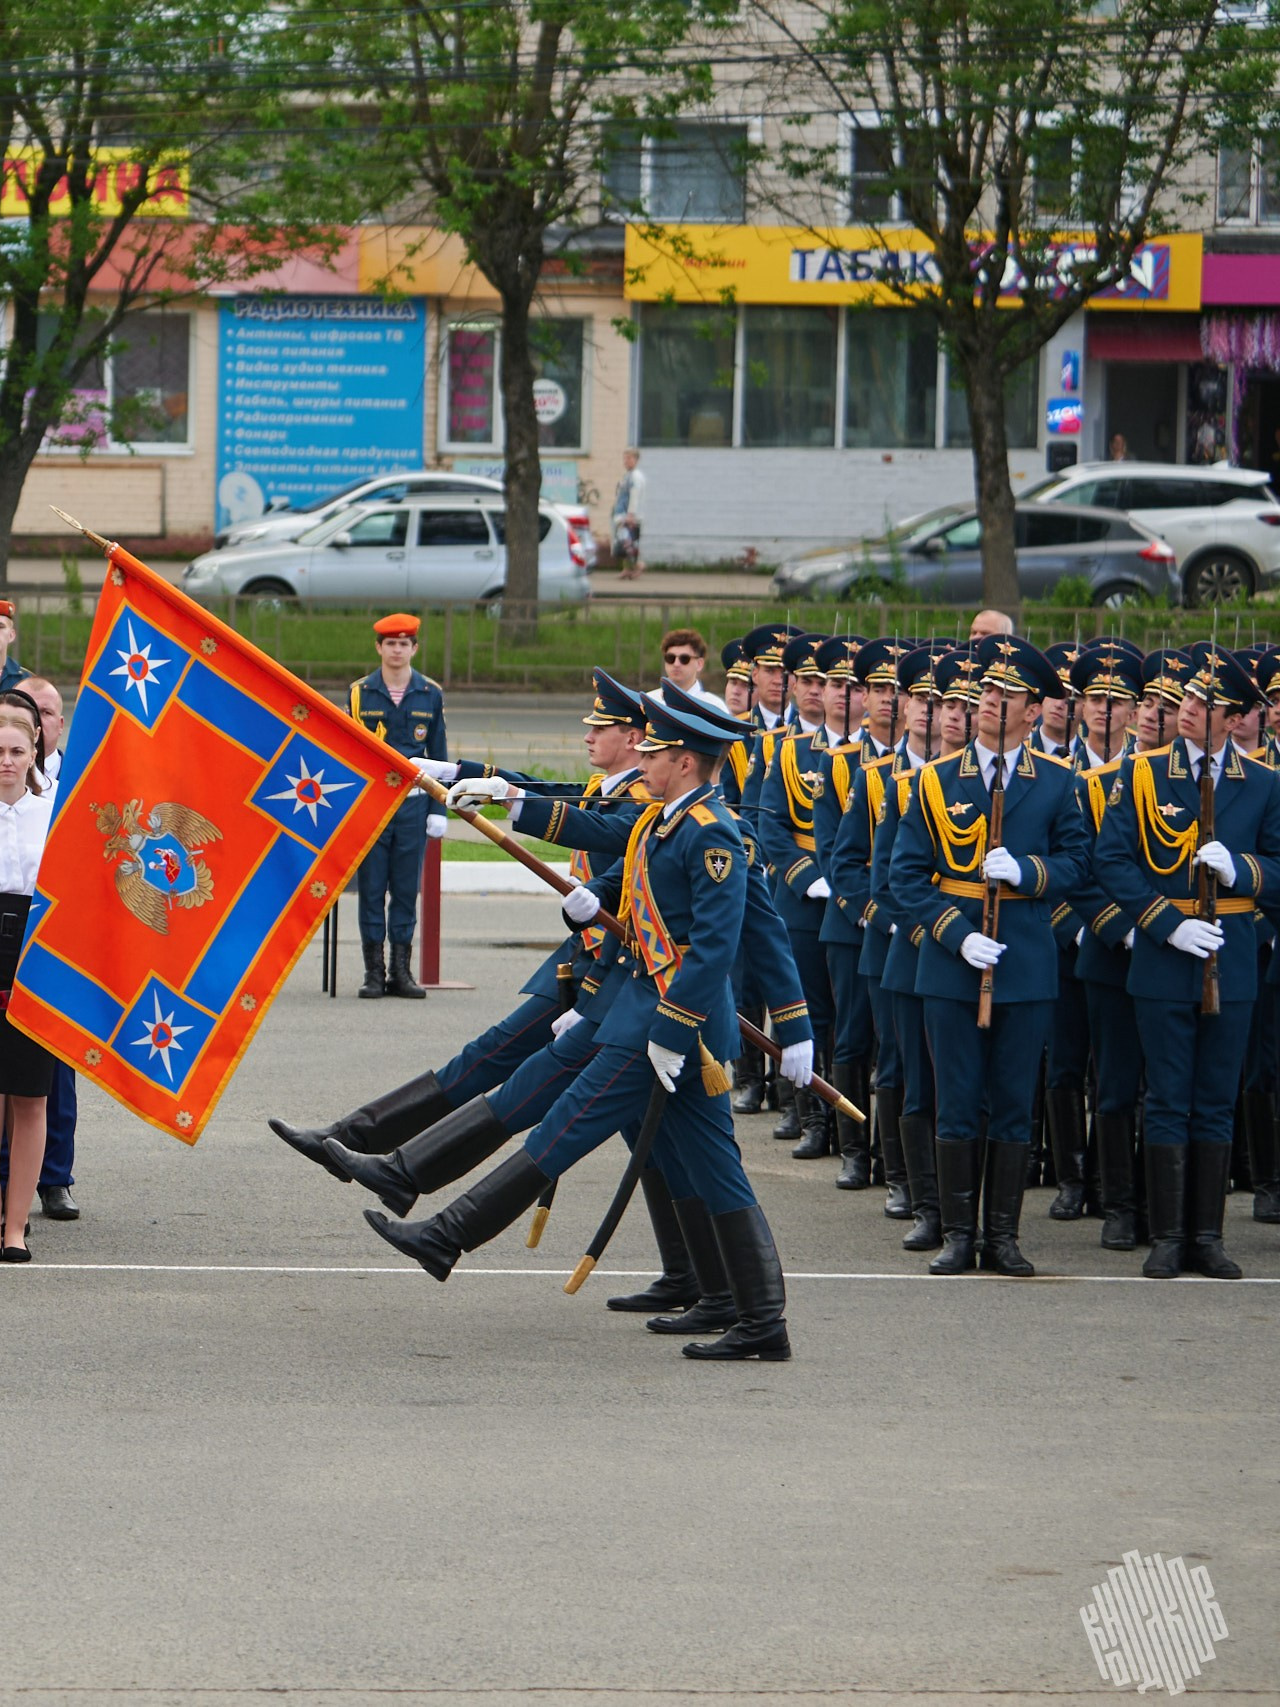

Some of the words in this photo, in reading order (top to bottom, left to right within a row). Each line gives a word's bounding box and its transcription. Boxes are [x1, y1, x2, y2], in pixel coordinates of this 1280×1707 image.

[791, 248, 944, 281] ТАБАК
[234, 300, 417, 321] РАДИОТЕХНИКА
[385, 330, 404, 341] ТВ
[236, 344, 279, 356] Блоки
[282, 347, 345, 357] питания
[235, 361, 279, 373] Видео
[235, 378, 340, 393] Инструменты
[235, 395, 289, 407] Кабель,
[292, 398, 341, 410] шнуры
[344, 398, 408, 409] питания
[234, 428, 287, 441] Фонари
